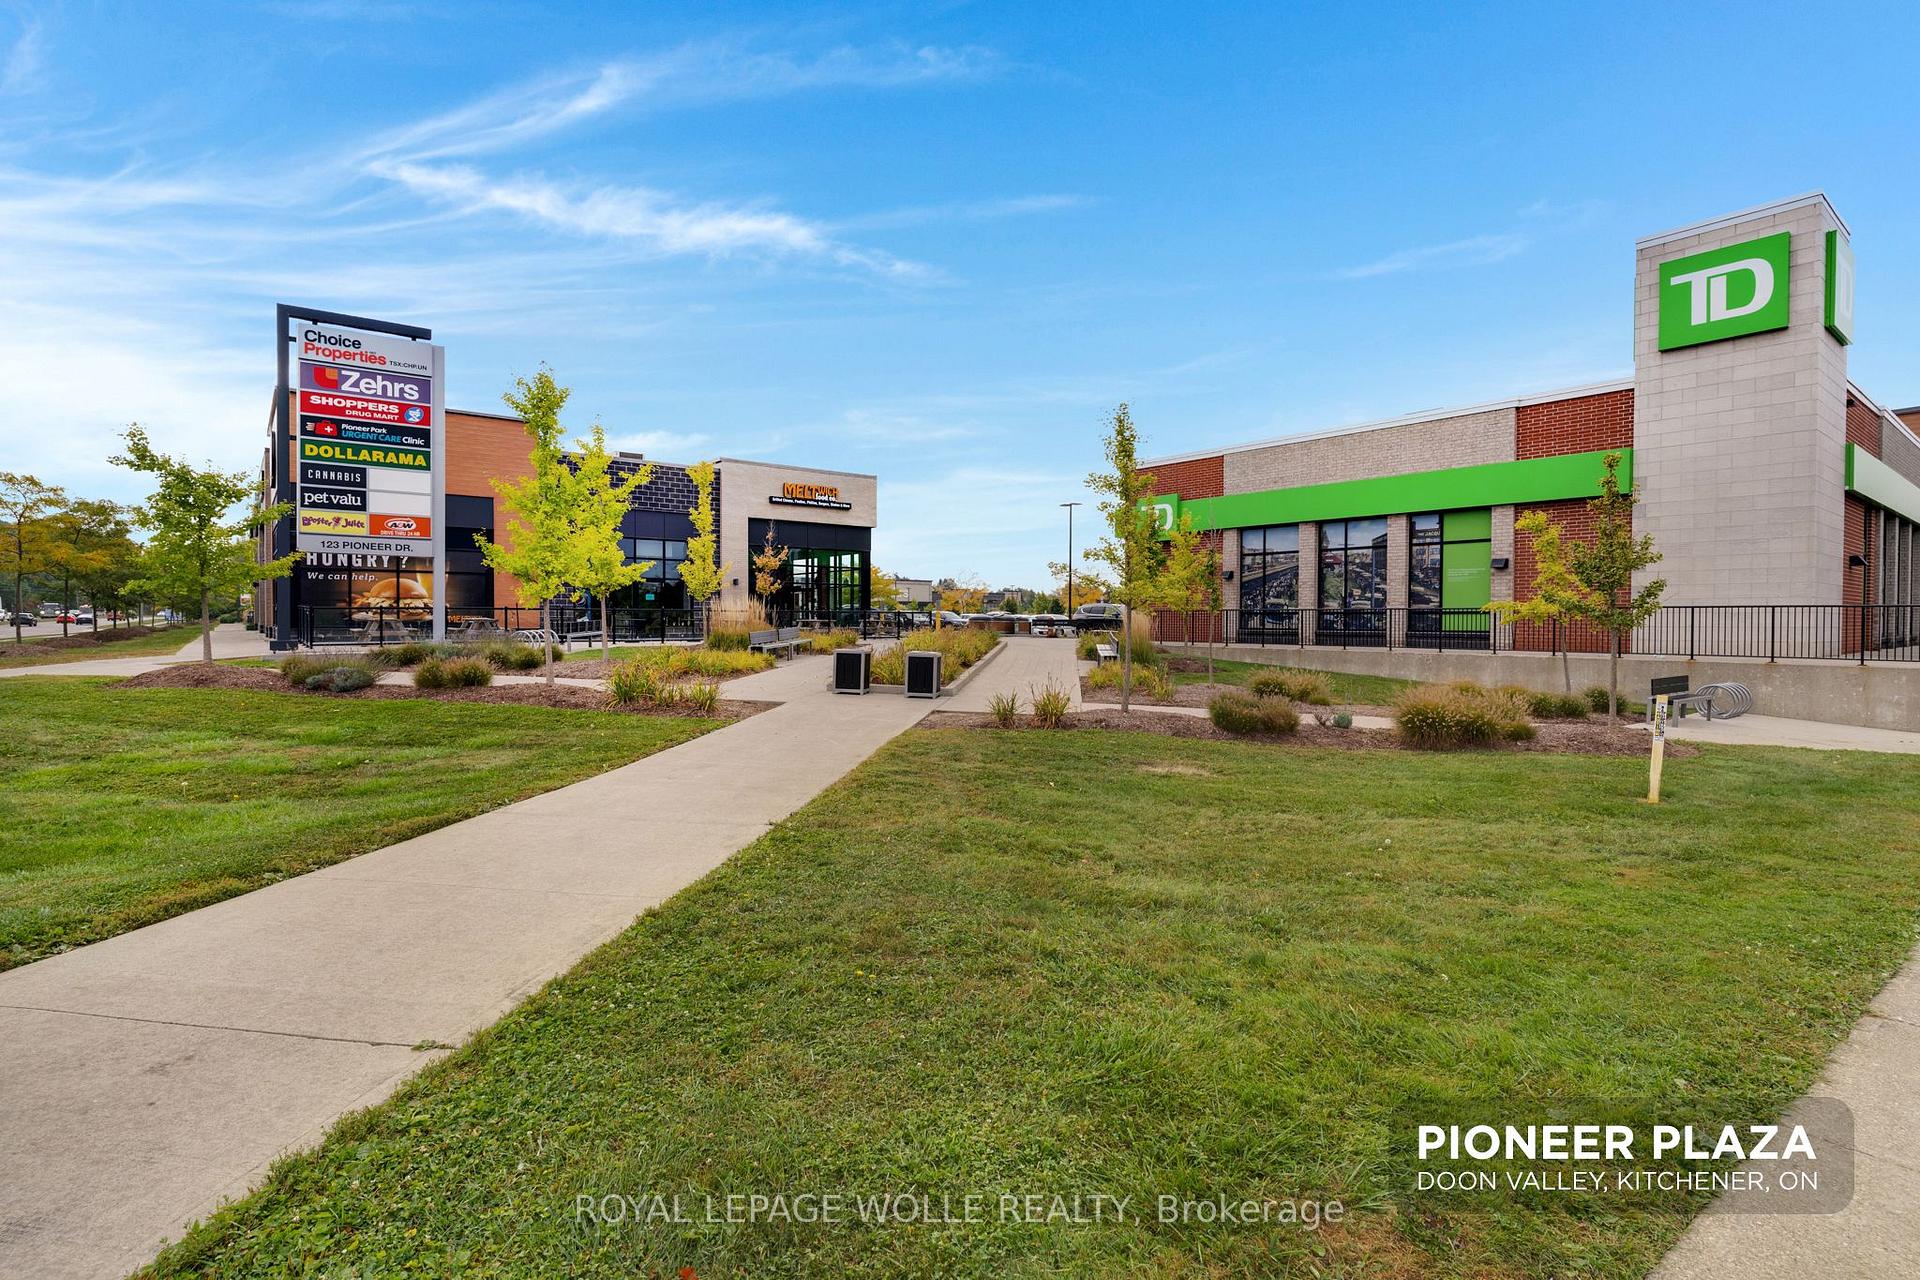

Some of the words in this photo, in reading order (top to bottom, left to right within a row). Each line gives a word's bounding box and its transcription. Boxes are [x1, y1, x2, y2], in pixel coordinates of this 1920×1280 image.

[1670, 258, 1774, 326] TD
[304, 329, 362, 349] Choice
[304, 342, 387, 366] Properties
[341, 370, 419, 401] Zehrs
[309, 395, 399, 414] SHOPPERS
[345, 409, 372, 418] DRUG
[373, 412, 399, 421] MART
[341, 423, 370, 433] Pioneer
[370, 426, 387, 434] Park
[341, 430, 378, 441] URGENT
[378, 434, 401, 443] CARE
[402, 436, 425, 446] Clinic
[304, 443, 427, 467] DOLLARAMA
[307, 469, 361, 482] CANNABIS
[783, 482, 839, 498] MELTWICH
[303, 492, 329, 505] pet
[330, 493, 362, 506] valu
[301, 516, 333, 527] Booster
[341, 518, 365, 528] Juice
[320, 540, 340, 549] 123
[342, 542, 392, 551] PIONEER
[395, 544, 414, 552] DR.
[306, 552, 390, 568] HUNGRY
[307, 571, 325, 580] We
[351, 572, 379, 582] help.
